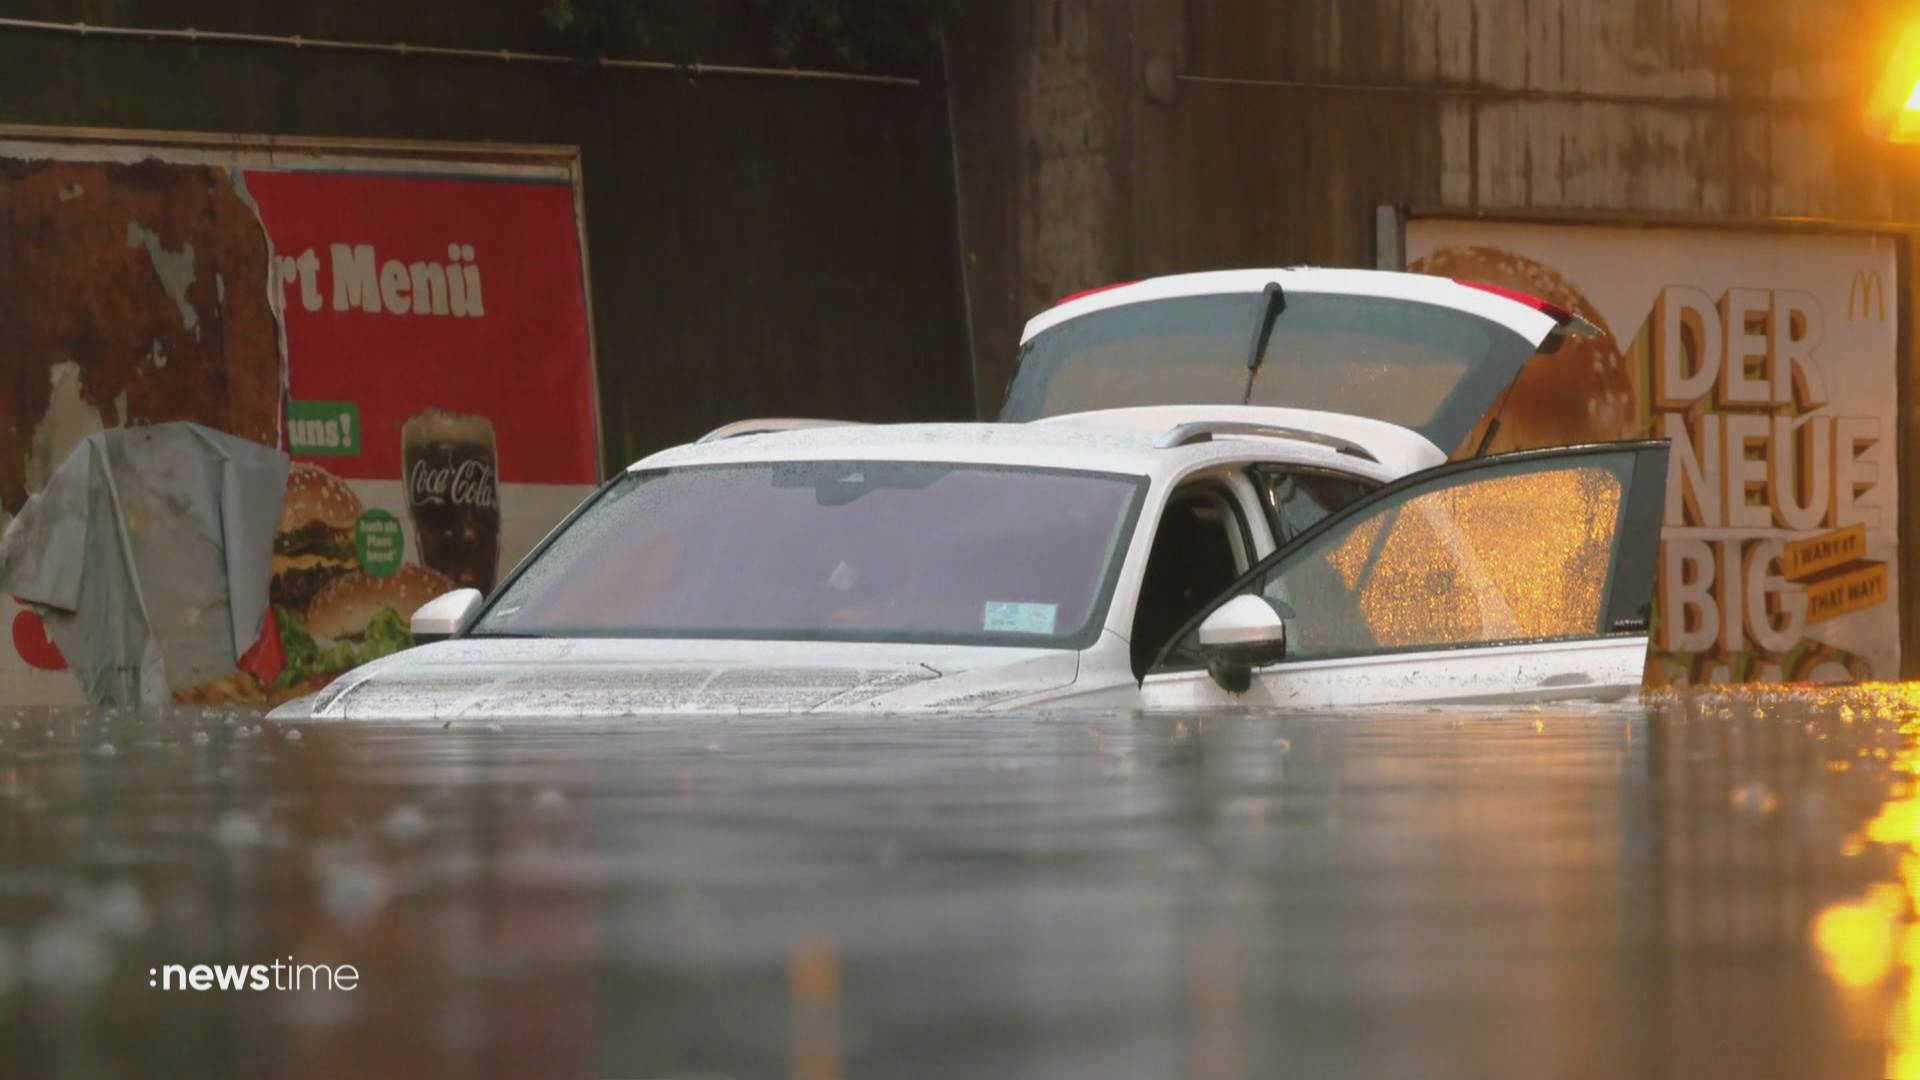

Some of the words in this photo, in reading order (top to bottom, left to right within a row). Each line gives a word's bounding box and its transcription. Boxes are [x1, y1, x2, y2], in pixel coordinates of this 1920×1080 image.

[330, 243, 485, 317] Menü
[1658, 284, 1830, 407] DER
[288, 413, 352, 448] uns!
[1662, 411, 1882, 531] NEUE
[1801, 539, 1842, 567] WANT
[1843, 535, 1857, 556] IT
[1660, 537, 1808, 654] BIG
[1810, 586, 1844, 616] THAT
